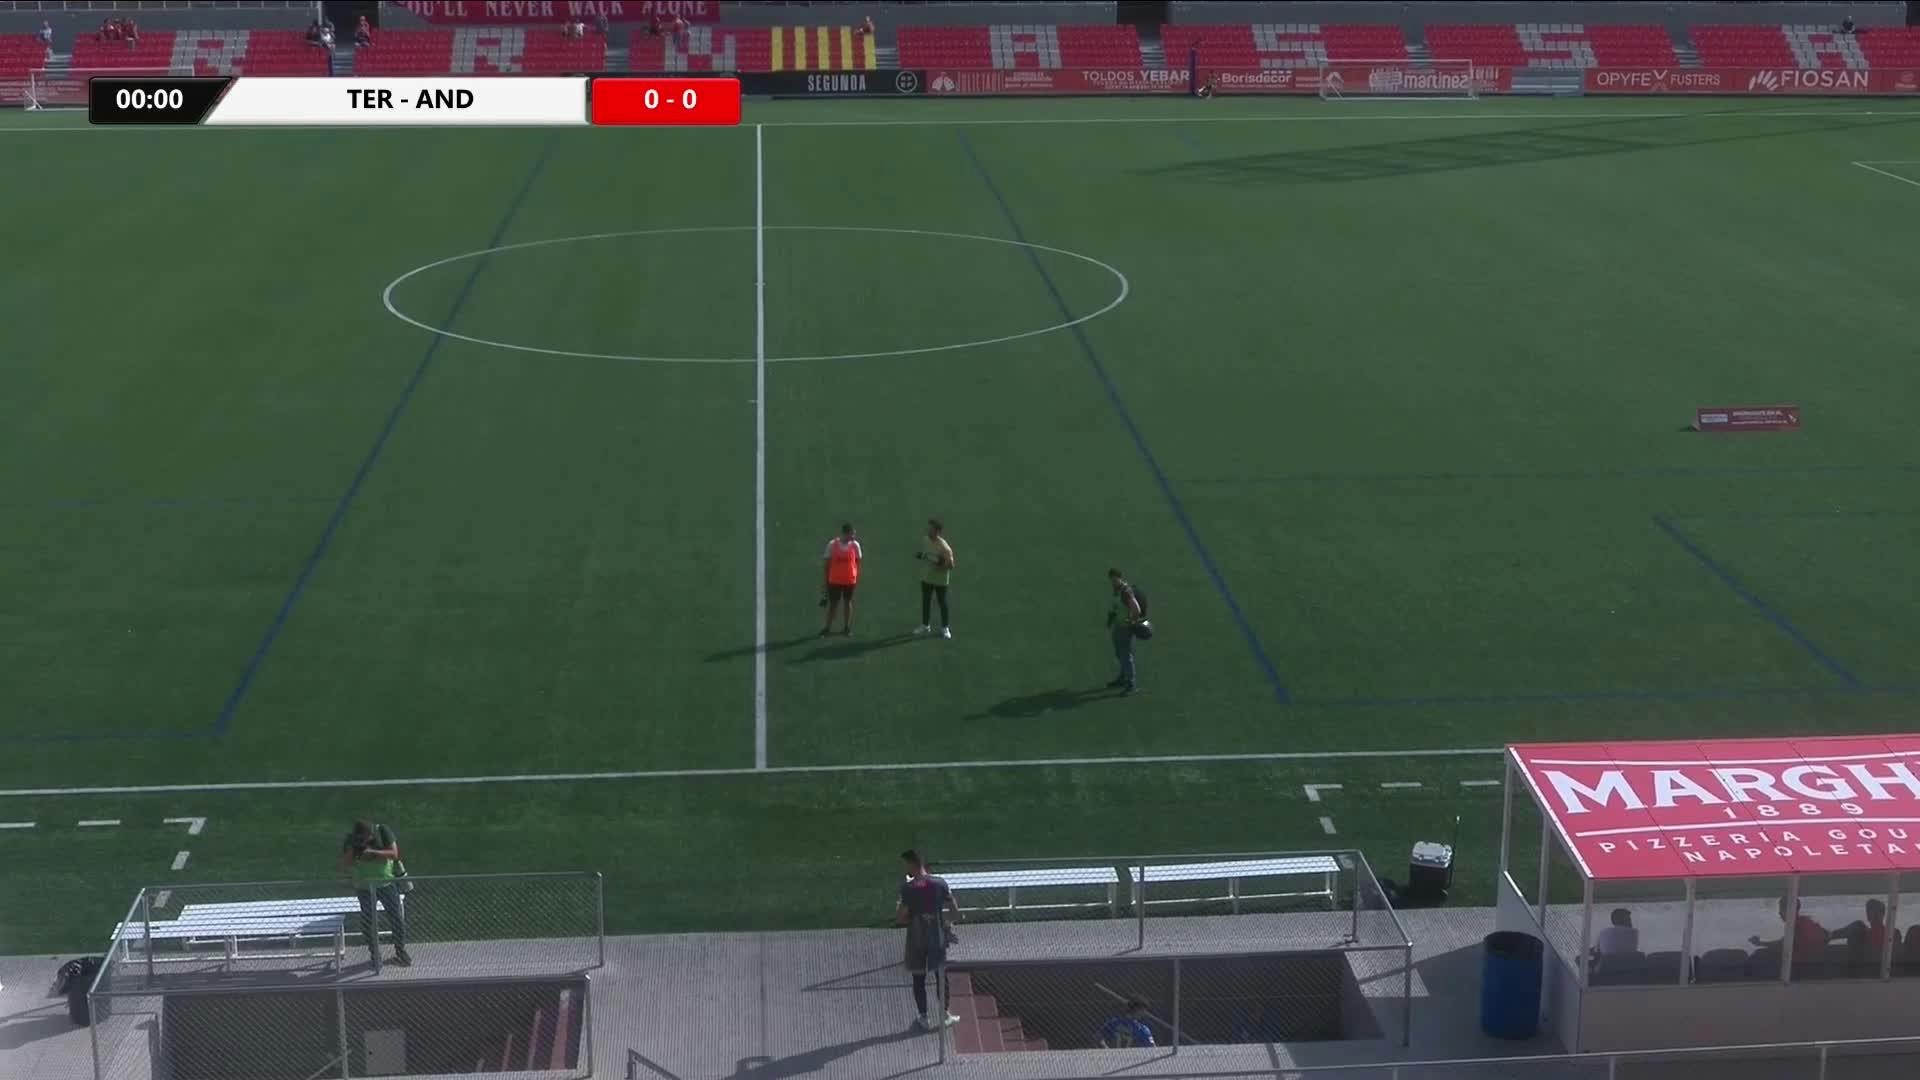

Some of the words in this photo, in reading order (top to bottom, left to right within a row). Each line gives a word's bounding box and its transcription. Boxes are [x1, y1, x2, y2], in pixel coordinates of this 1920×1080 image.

[407, 1, 467, 16] OU'LL
[486, 1, 554, 16] NEVER
[568, 1, 624, 17] WALK
[641, 1, 708, 16] ALONE
[808, 74, 866, 91] SEGUNDA
[1082, 71, 1135, 81] TOLDOS
[1140, 70, 1190, 81] YEBAR
[1221, 72, 1292, 83] Borisdecor
[1405, 72, 1469, 88] martinez
[1670, 73, 1720, 86] FUSTERS
[1780, 70, 1869, 87] FIOSAN
[1540, 762, 1920, 814] MARGH
[1723, 801, 1865, 819] 1889
[1599, 831, 1801, 854] PIZZERIA
[1684, 842, 1920, 863] NAPOLETA
